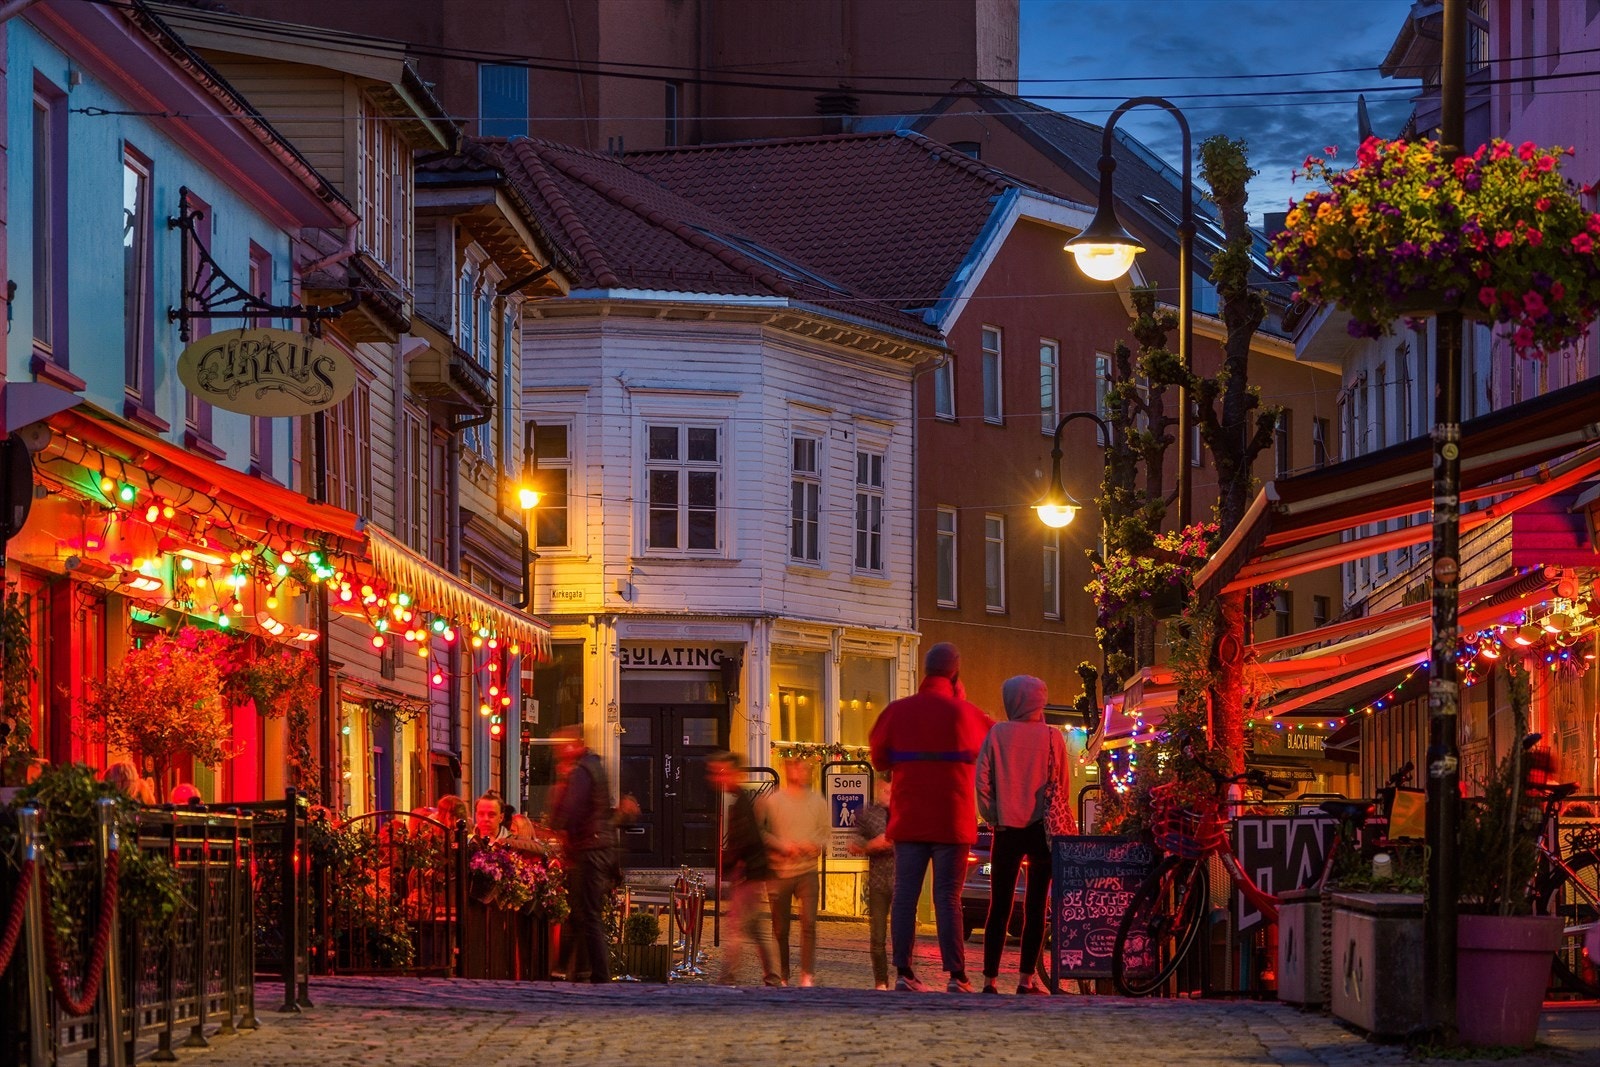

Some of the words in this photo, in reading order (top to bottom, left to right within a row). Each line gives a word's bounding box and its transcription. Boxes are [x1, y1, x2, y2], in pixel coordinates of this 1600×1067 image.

[197, 335, 336, 404] CIRKUS
[552, 590, 583, 600] Kirkegata
[620, 647, 726, 666] GULATING
[1287, 733, 1304, 749] BLACK
[1309, 735, 1324, 751] WHITE
[834, 777, 862, 788] Sone
[836, 794, 859, 802] Gågate
[1063, 866, 1082, 879] HER
[1102, 868, 1114, 876] DU
[1085, 877, 1124, 891] VIPPS!
[1062, 890, 1082, 906] SE
[1062, 907, 1086, 921] QR
